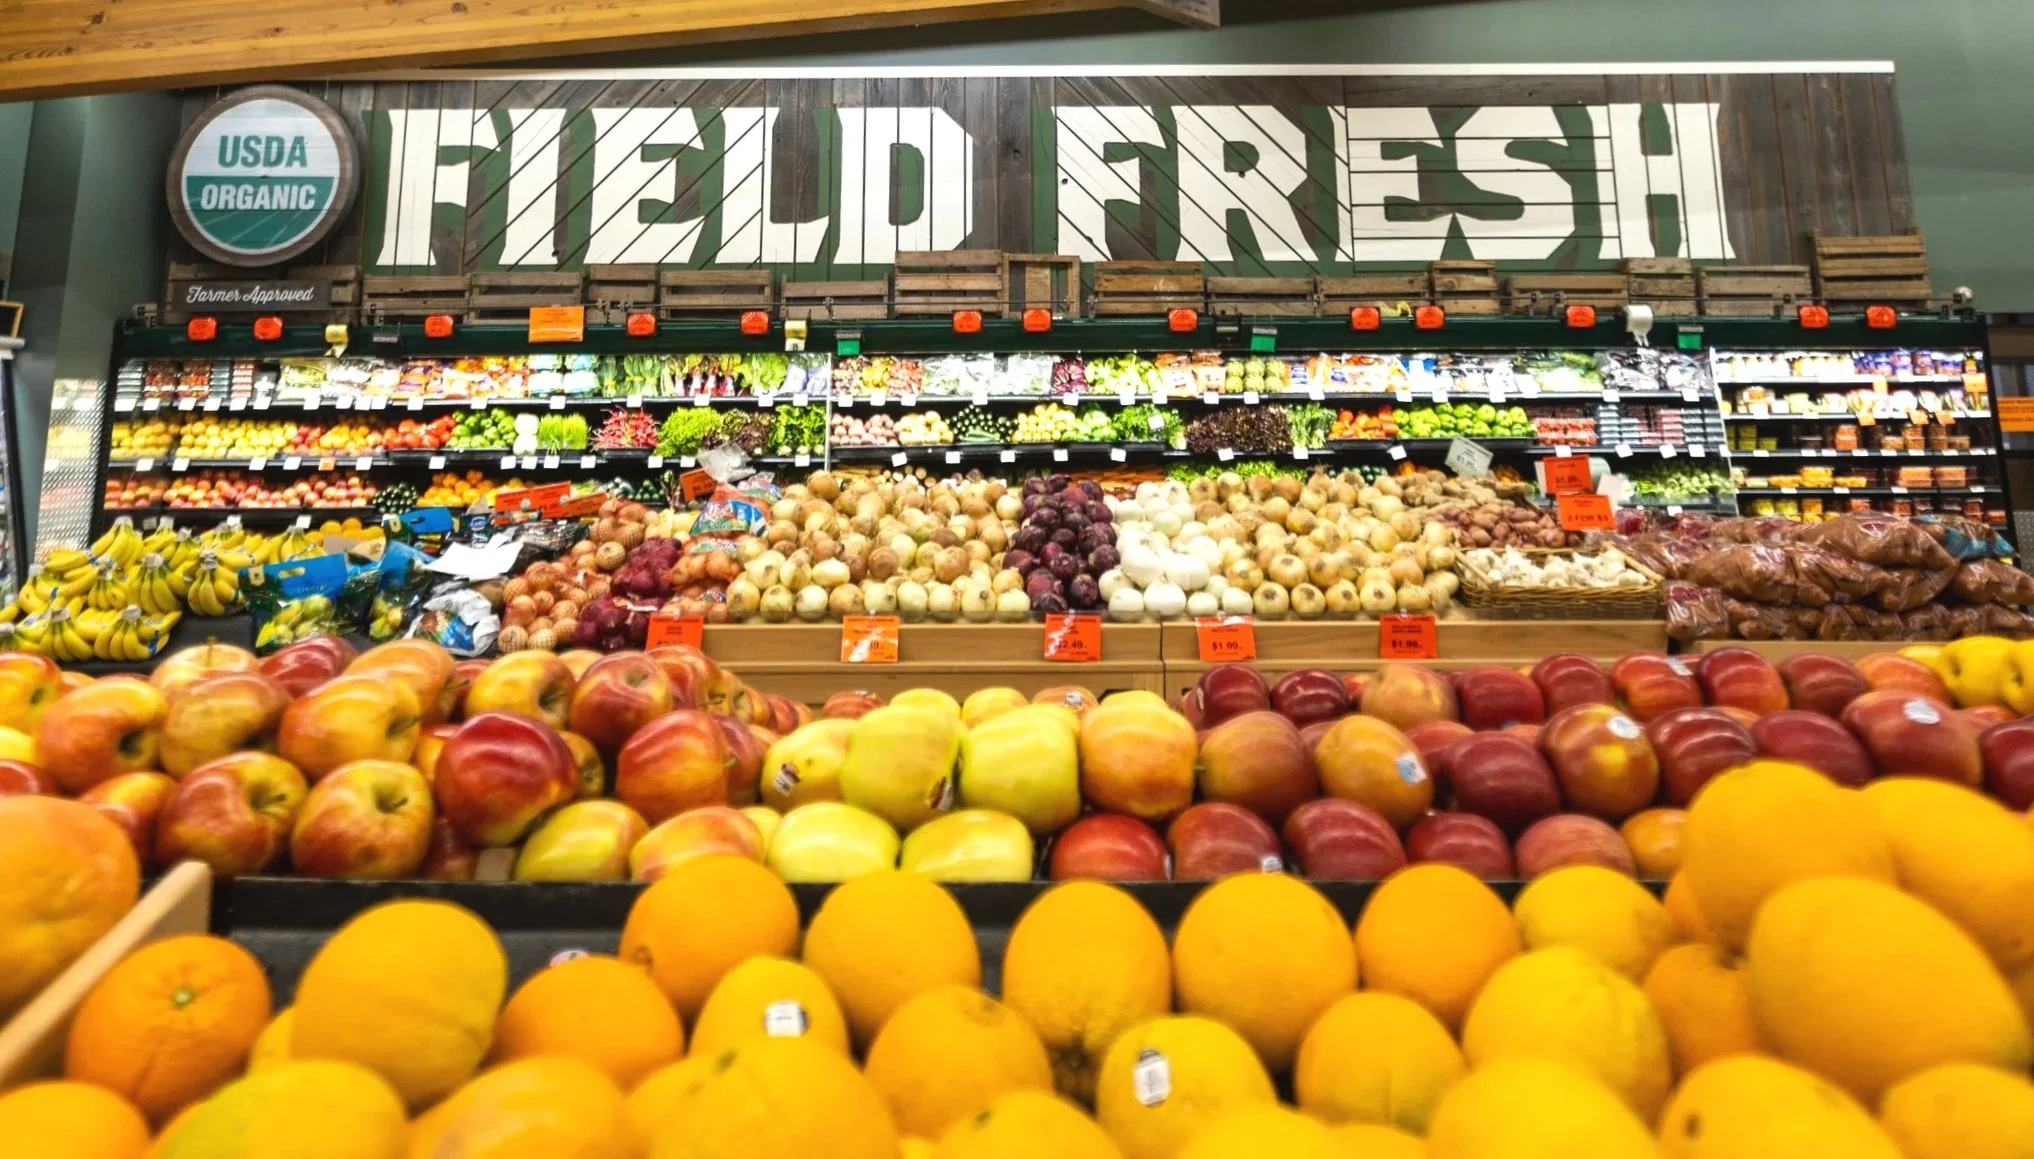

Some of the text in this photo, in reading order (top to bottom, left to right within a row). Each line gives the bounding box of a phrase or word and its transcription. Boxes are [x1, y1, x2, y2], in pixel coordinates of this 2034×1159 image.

[218, 134, 308, 168] USDA
[200, 183, 317, 211] ORGANIC
[375, 103, 1737, 265] FIELD FRESH
[186, 284, 315, 305] Farmer Approved
